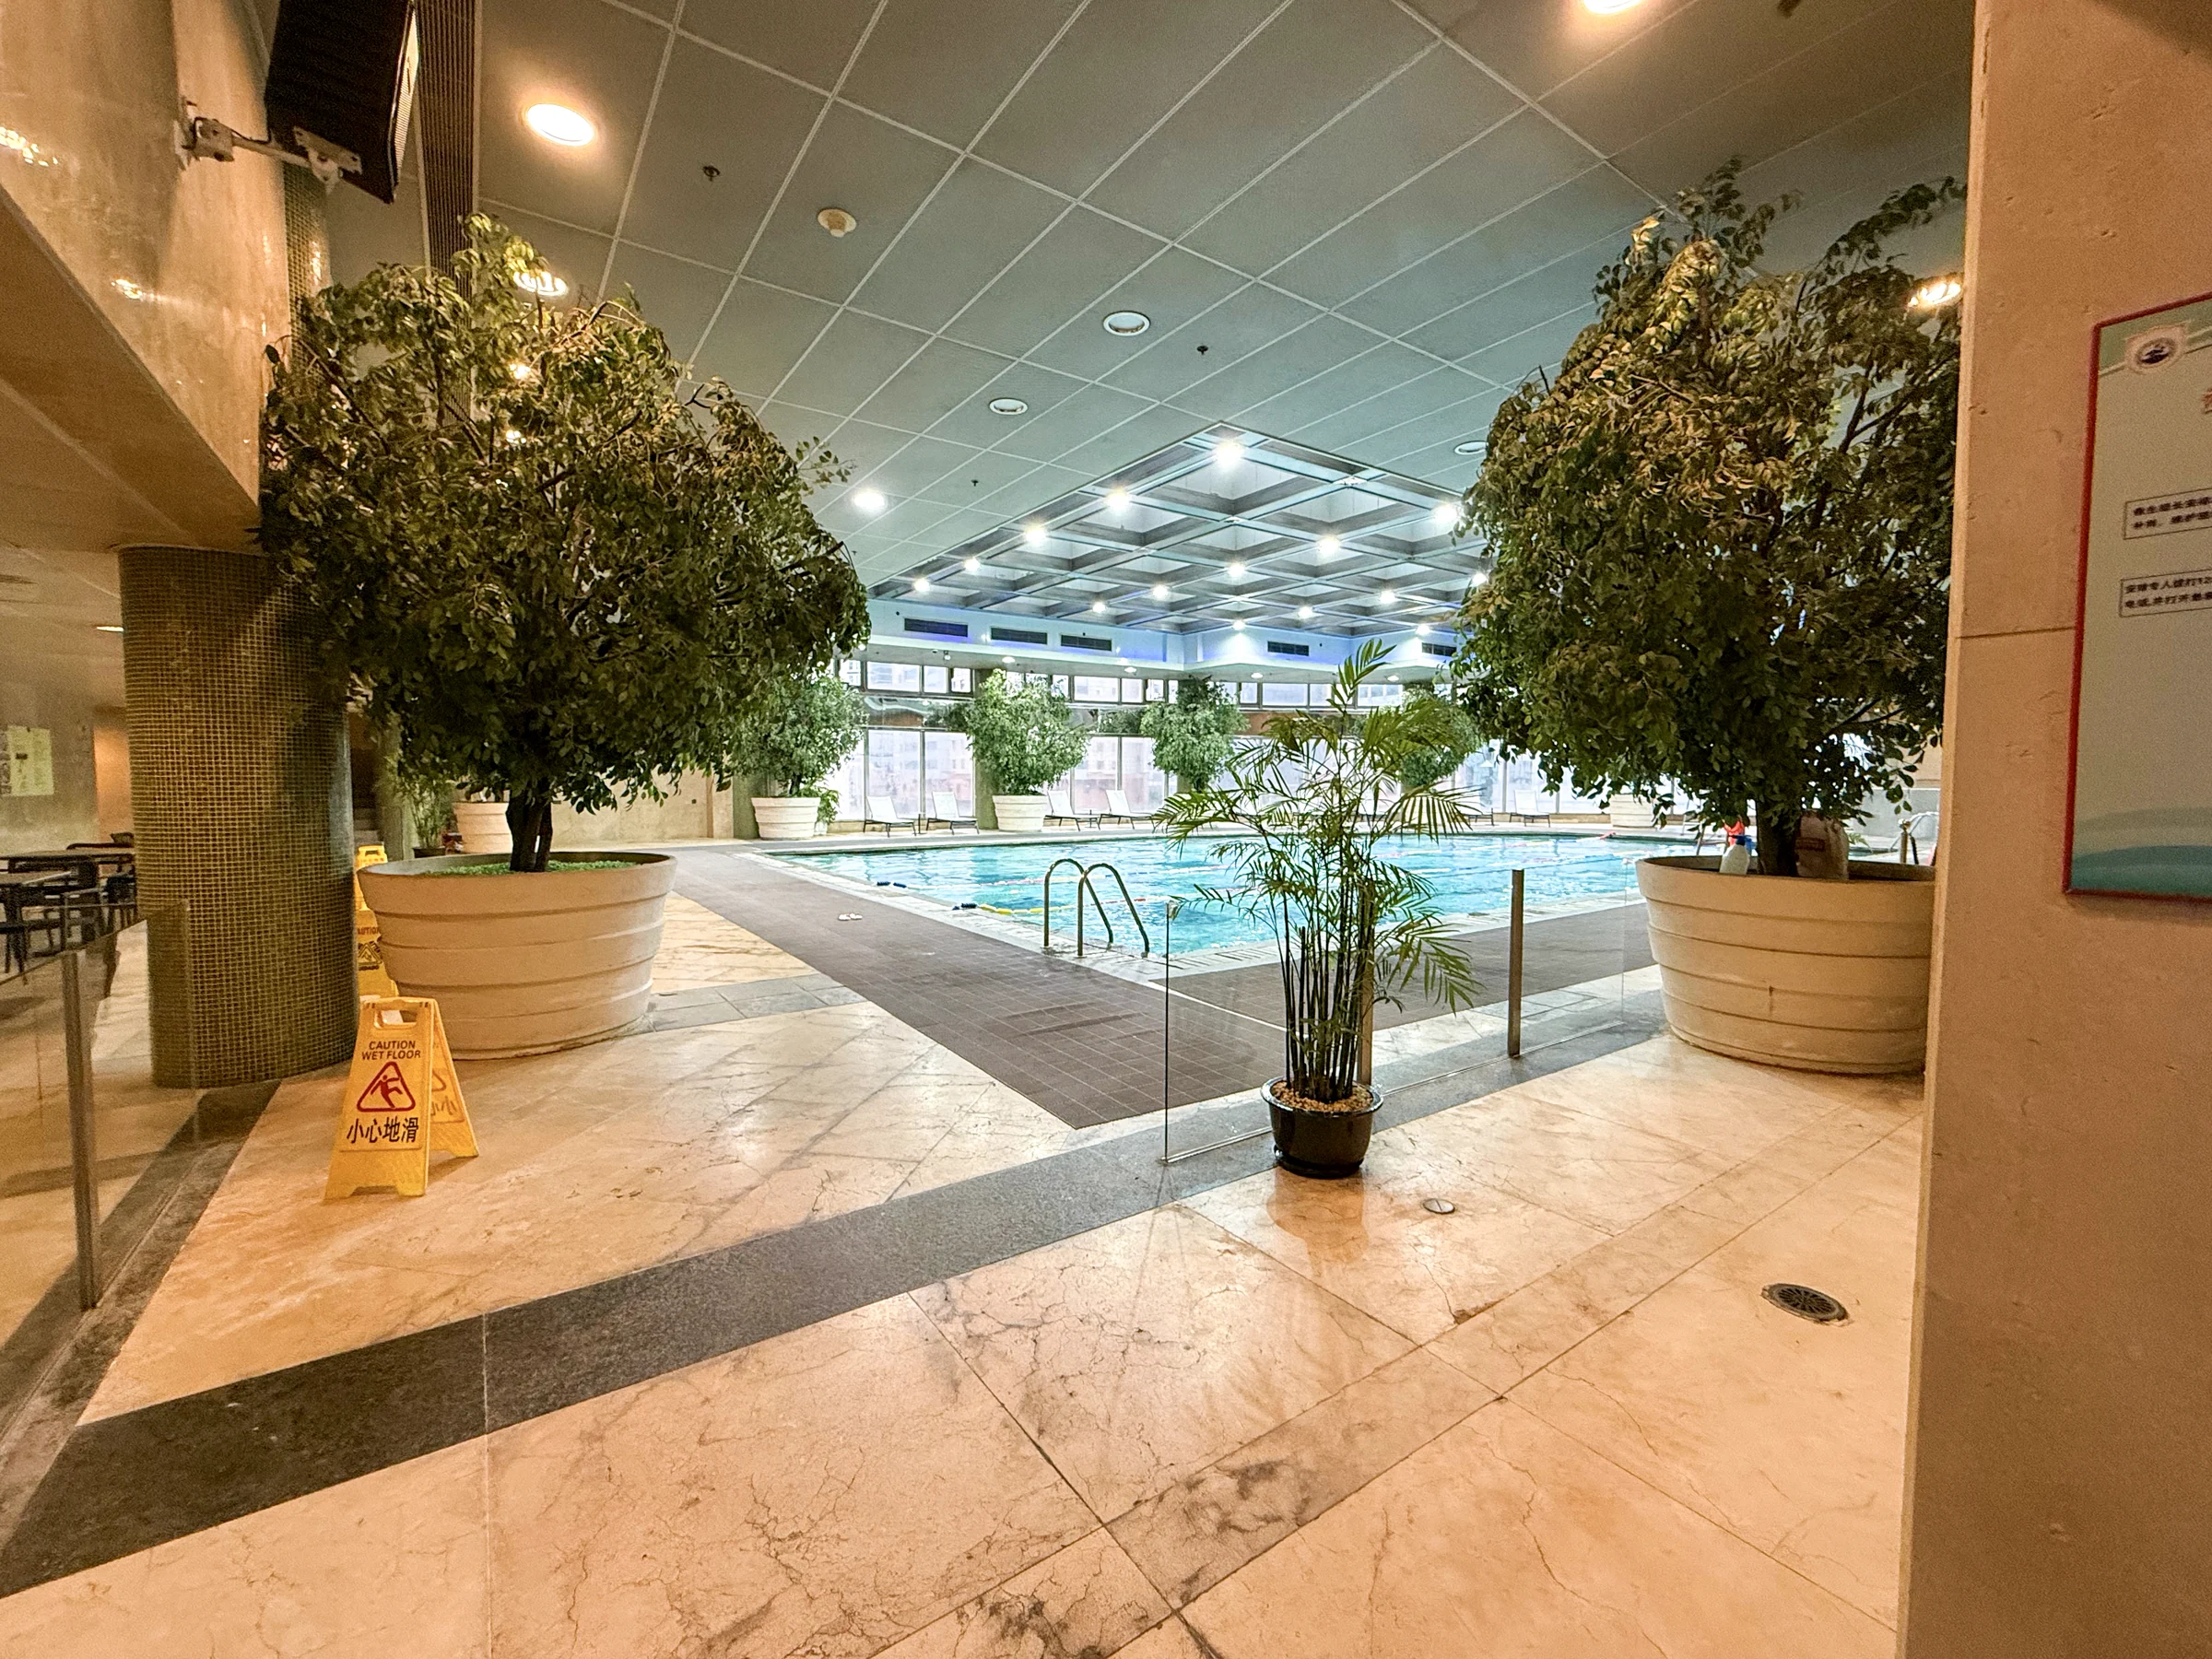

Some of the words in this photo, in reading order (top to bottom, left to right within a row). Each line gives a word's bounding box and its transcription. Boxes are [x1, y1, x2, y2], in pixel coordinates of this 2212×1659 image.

[369, 1041, 416, 1050] CAUTION
[361, 1051, 383, 1060] WET
[386, 1050, 421, 1059] FLOOR
[347, 1115, 418, 1144] 小心地滑
